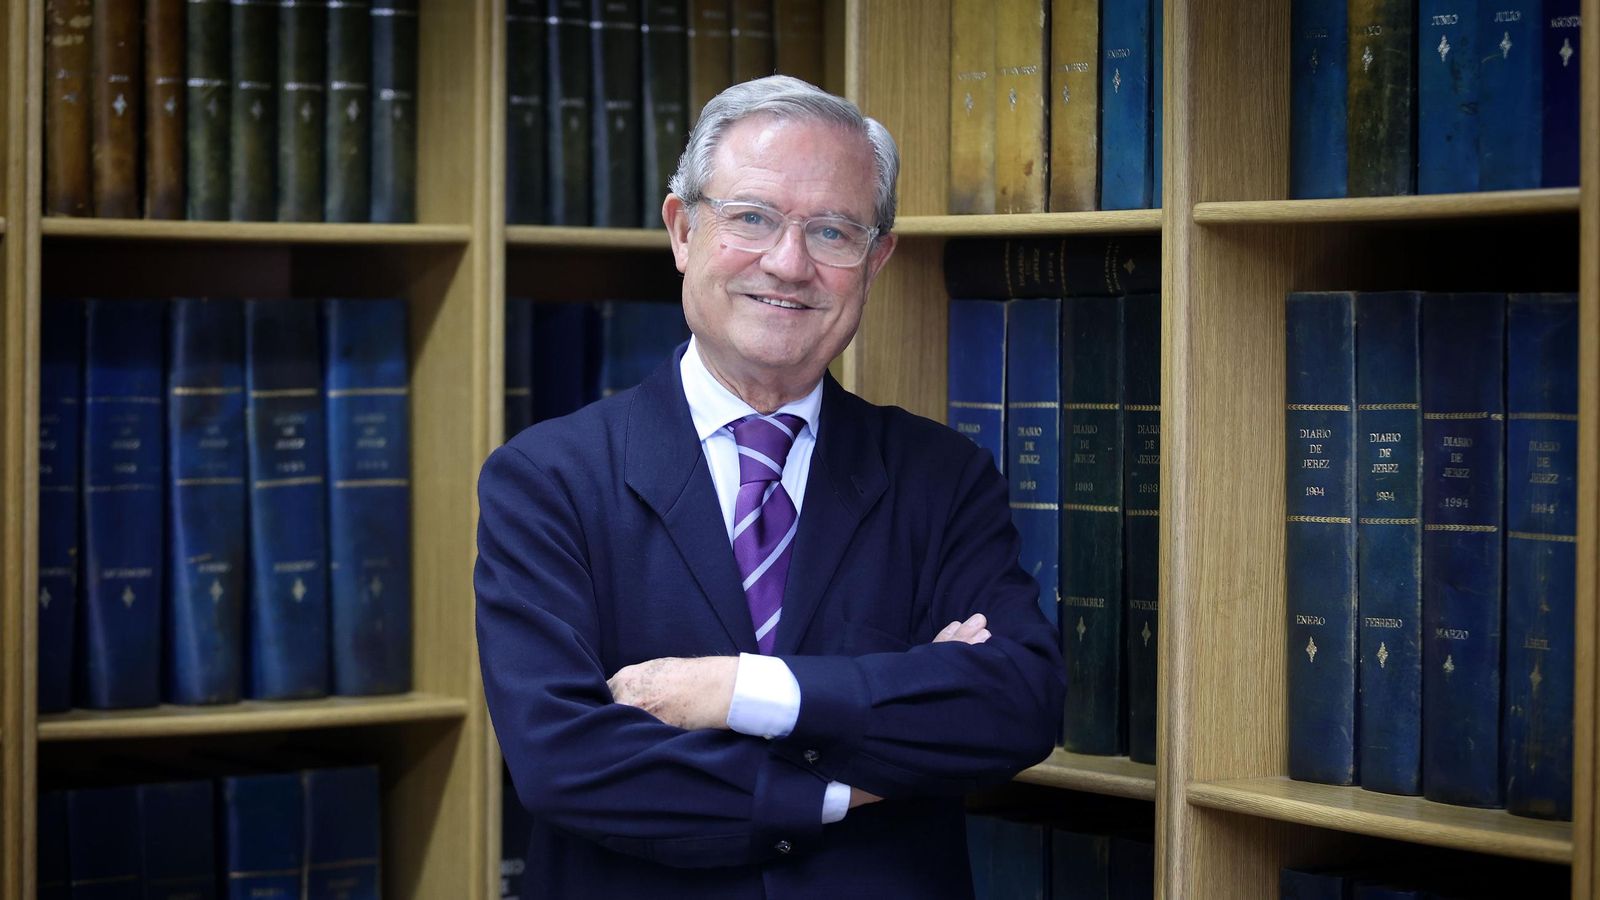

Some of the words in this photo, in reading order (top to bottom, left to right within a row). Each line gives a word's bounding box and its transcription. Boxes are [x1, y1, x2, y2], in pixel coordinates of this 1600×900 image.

[1432, 14, 1458, 26] JUNIO
[1494, 10, 1521, 22] JULIO
[1018, 426, 1042, 436] DIARIO
[1072, 424, 1098, 434] DIARIO
[1300, 428, 1332, 439] DIARIO
[1370, 432, 1402, 444] DIARIO
[1443, 436, 1473, 448] DIARIO
[1024, 441, 1035, 451] DE
[1080, 440, 1090, 450] DE
[1145, 440, 1155, 450] DE
[1310, 444, 1322, 454] DE
[1379, 448, 1392, 458] DE
[1450, 452, 1464, 464] DE
[1019, 454, 1041, 464] JEREZ
[1074, 454, 1096, 464] JEREZ
[1137, 454, 1160, 464] JEREZ
[1302, 459, 1330, 470] JEREZ
[1372, 463, 1399, 474] JEREZ
[1443, 467, 1470, 478] JEREZ
[1305, 486, 1325, 497] 1994
[1376, 491, 1395, 502] 1994
[1444, 497, 1469, 508] 1994
[1130, 600, 1158, 610] NOVIEM
[1296, 614, 1326, 626] ENERO
[1365, 617, 1403, 629] FEBRERO
[1435, 628, 1470, 640] MARZO
